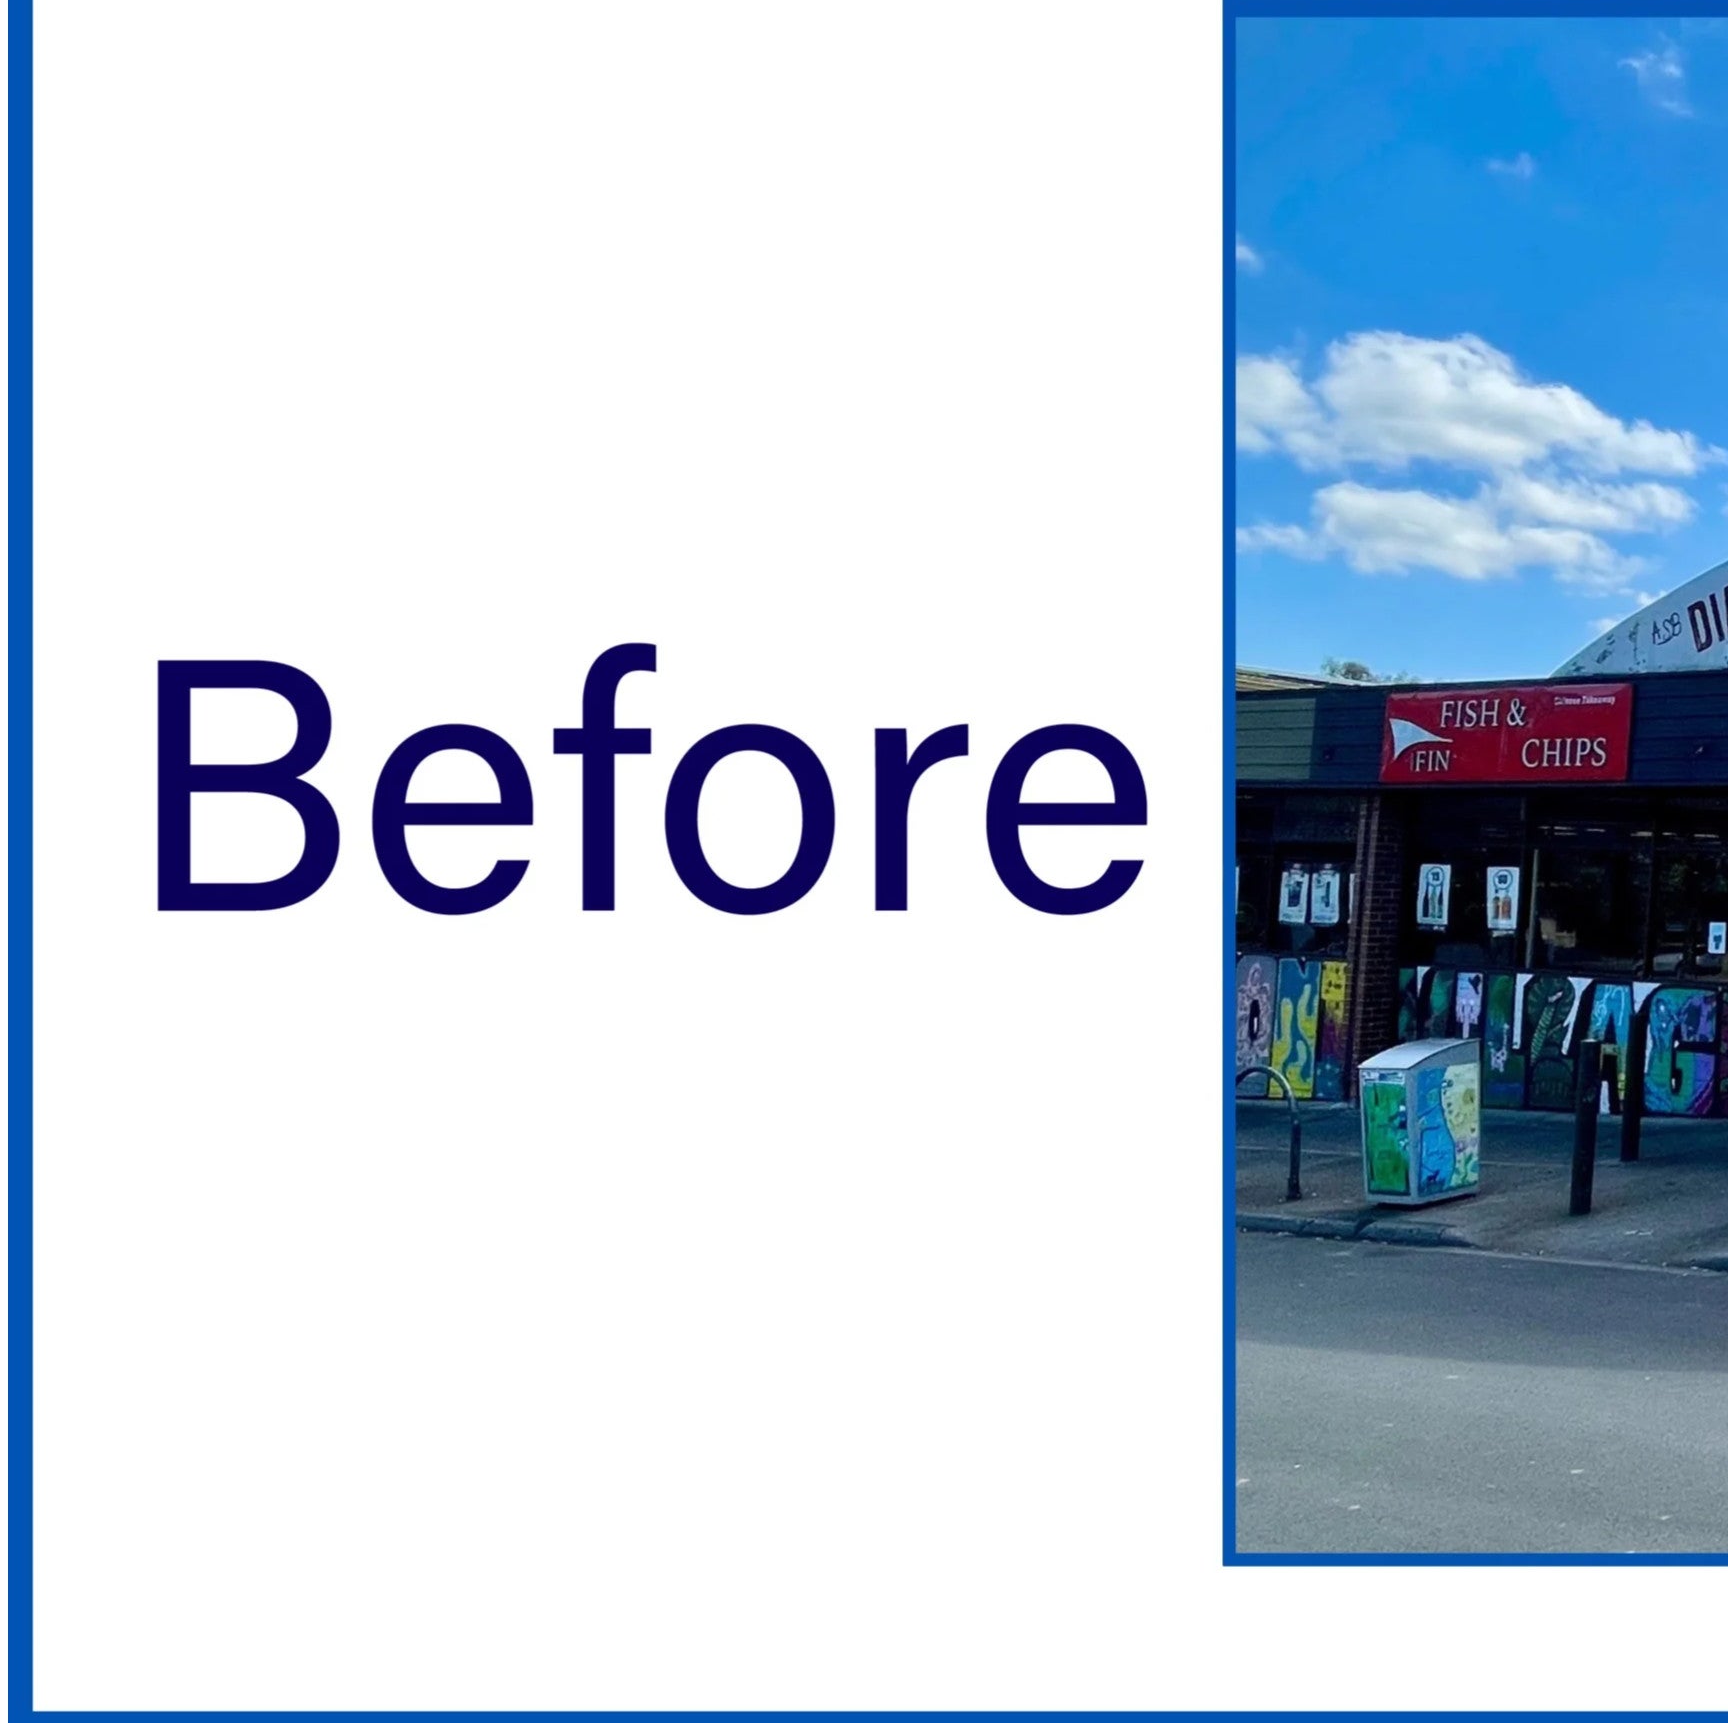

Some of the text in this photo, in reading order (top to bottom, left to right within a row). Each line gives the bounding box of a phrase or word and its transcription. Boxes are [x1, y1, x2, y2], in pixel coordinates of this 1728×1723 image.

[1440, 698, 1527, 728] FISH &
[1414, 749, 1451, 773] FIN
[1521, 736, 1607, 768] CHIPS
